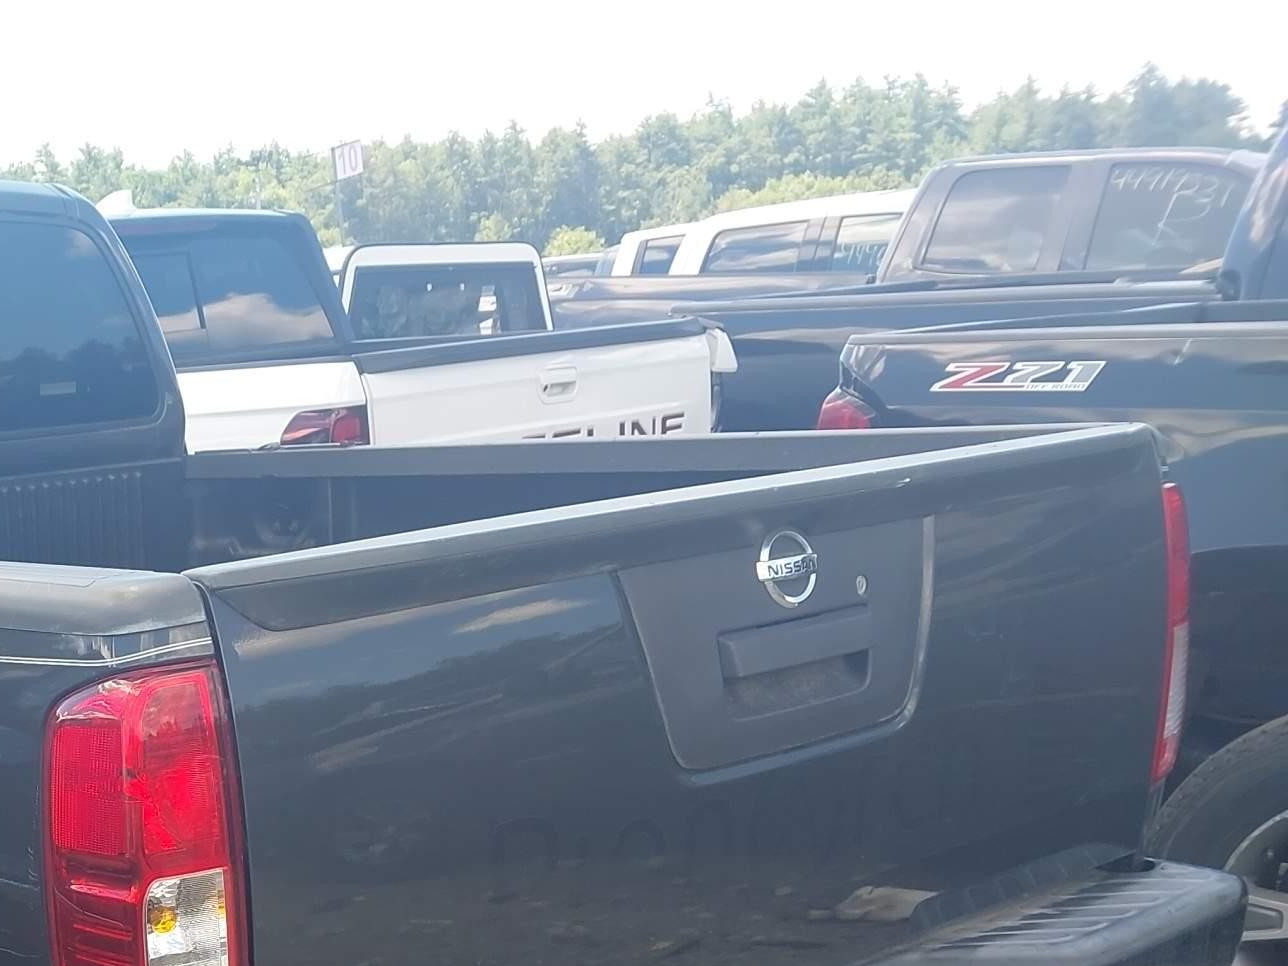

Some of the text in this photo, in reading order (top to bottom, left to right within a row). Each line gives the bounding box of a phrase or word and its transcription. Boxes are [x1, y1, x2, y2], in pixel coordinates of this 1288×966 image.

[337, 143, 359, 176] 10
[928, 361, 1107, 392] Z71
[767, 554, 818, 577] NISSAN
